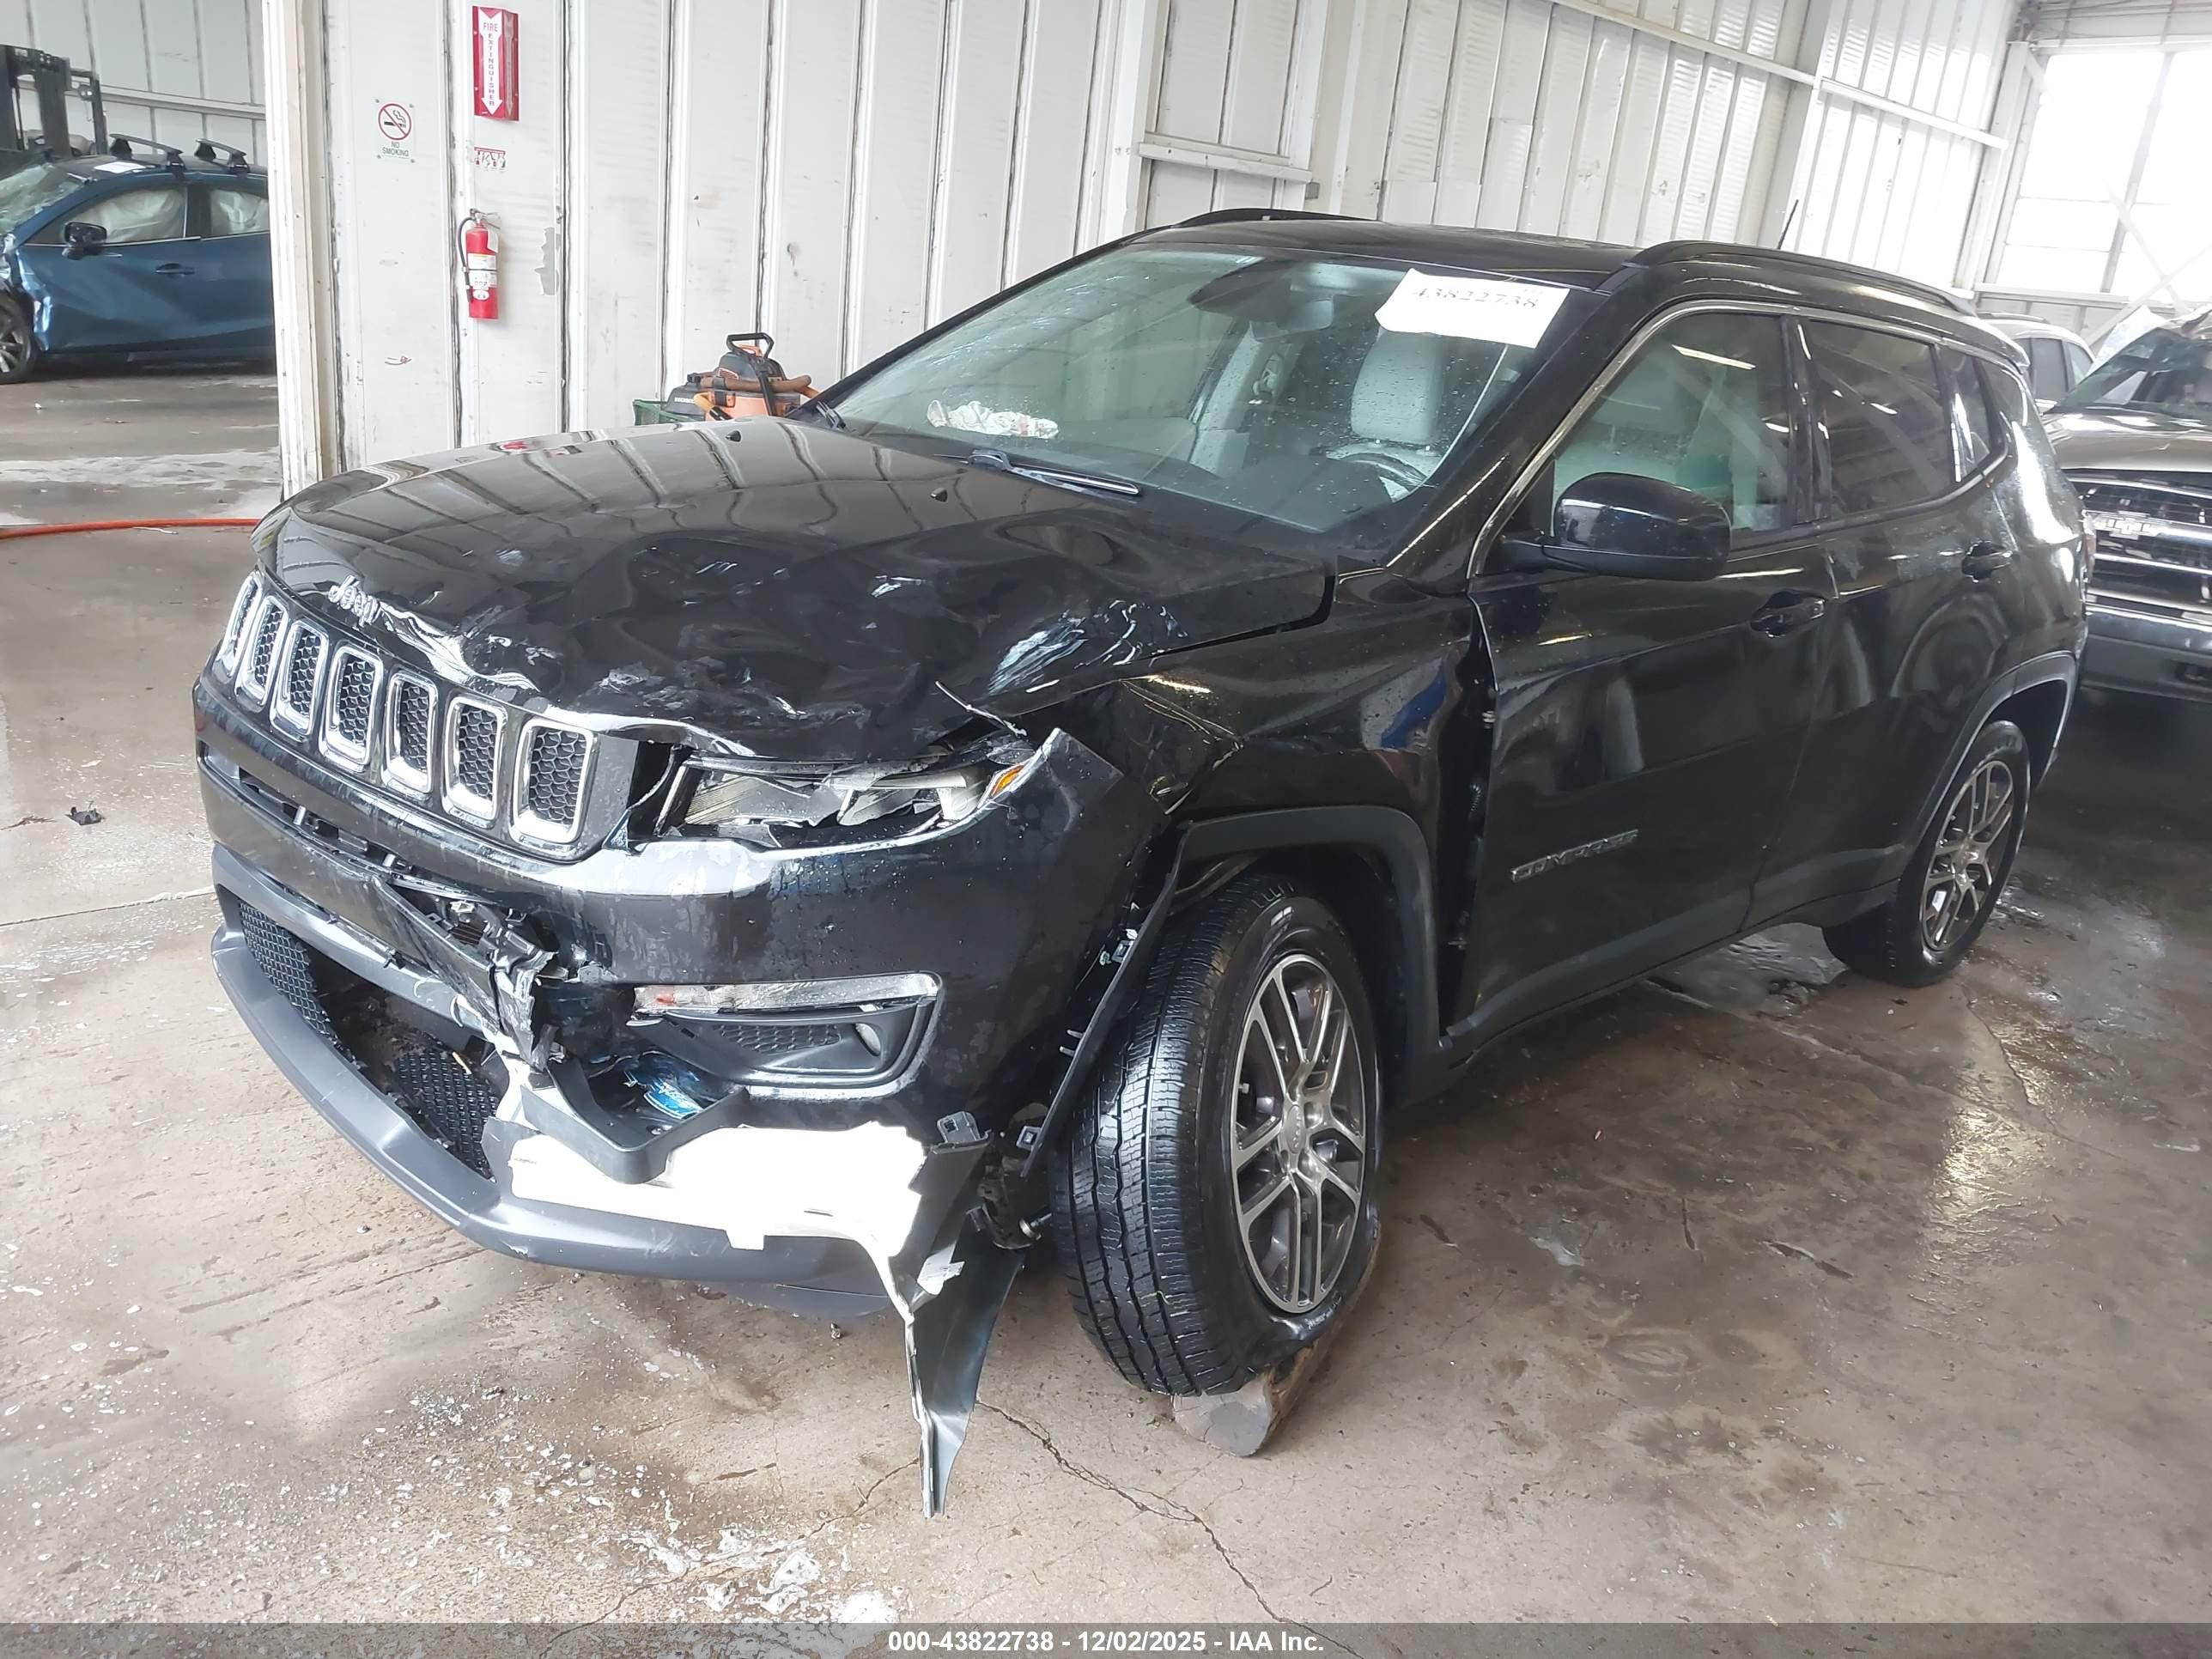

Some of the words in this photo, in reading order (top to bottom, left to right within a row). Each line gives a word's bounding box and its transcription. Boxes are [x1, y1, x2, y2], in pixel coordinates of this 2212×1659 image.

[483, 22, 498, 32] FIRE
[382, 147, 410, 157] SMOKING
[1414, 288, 1539, 308] 43822738
